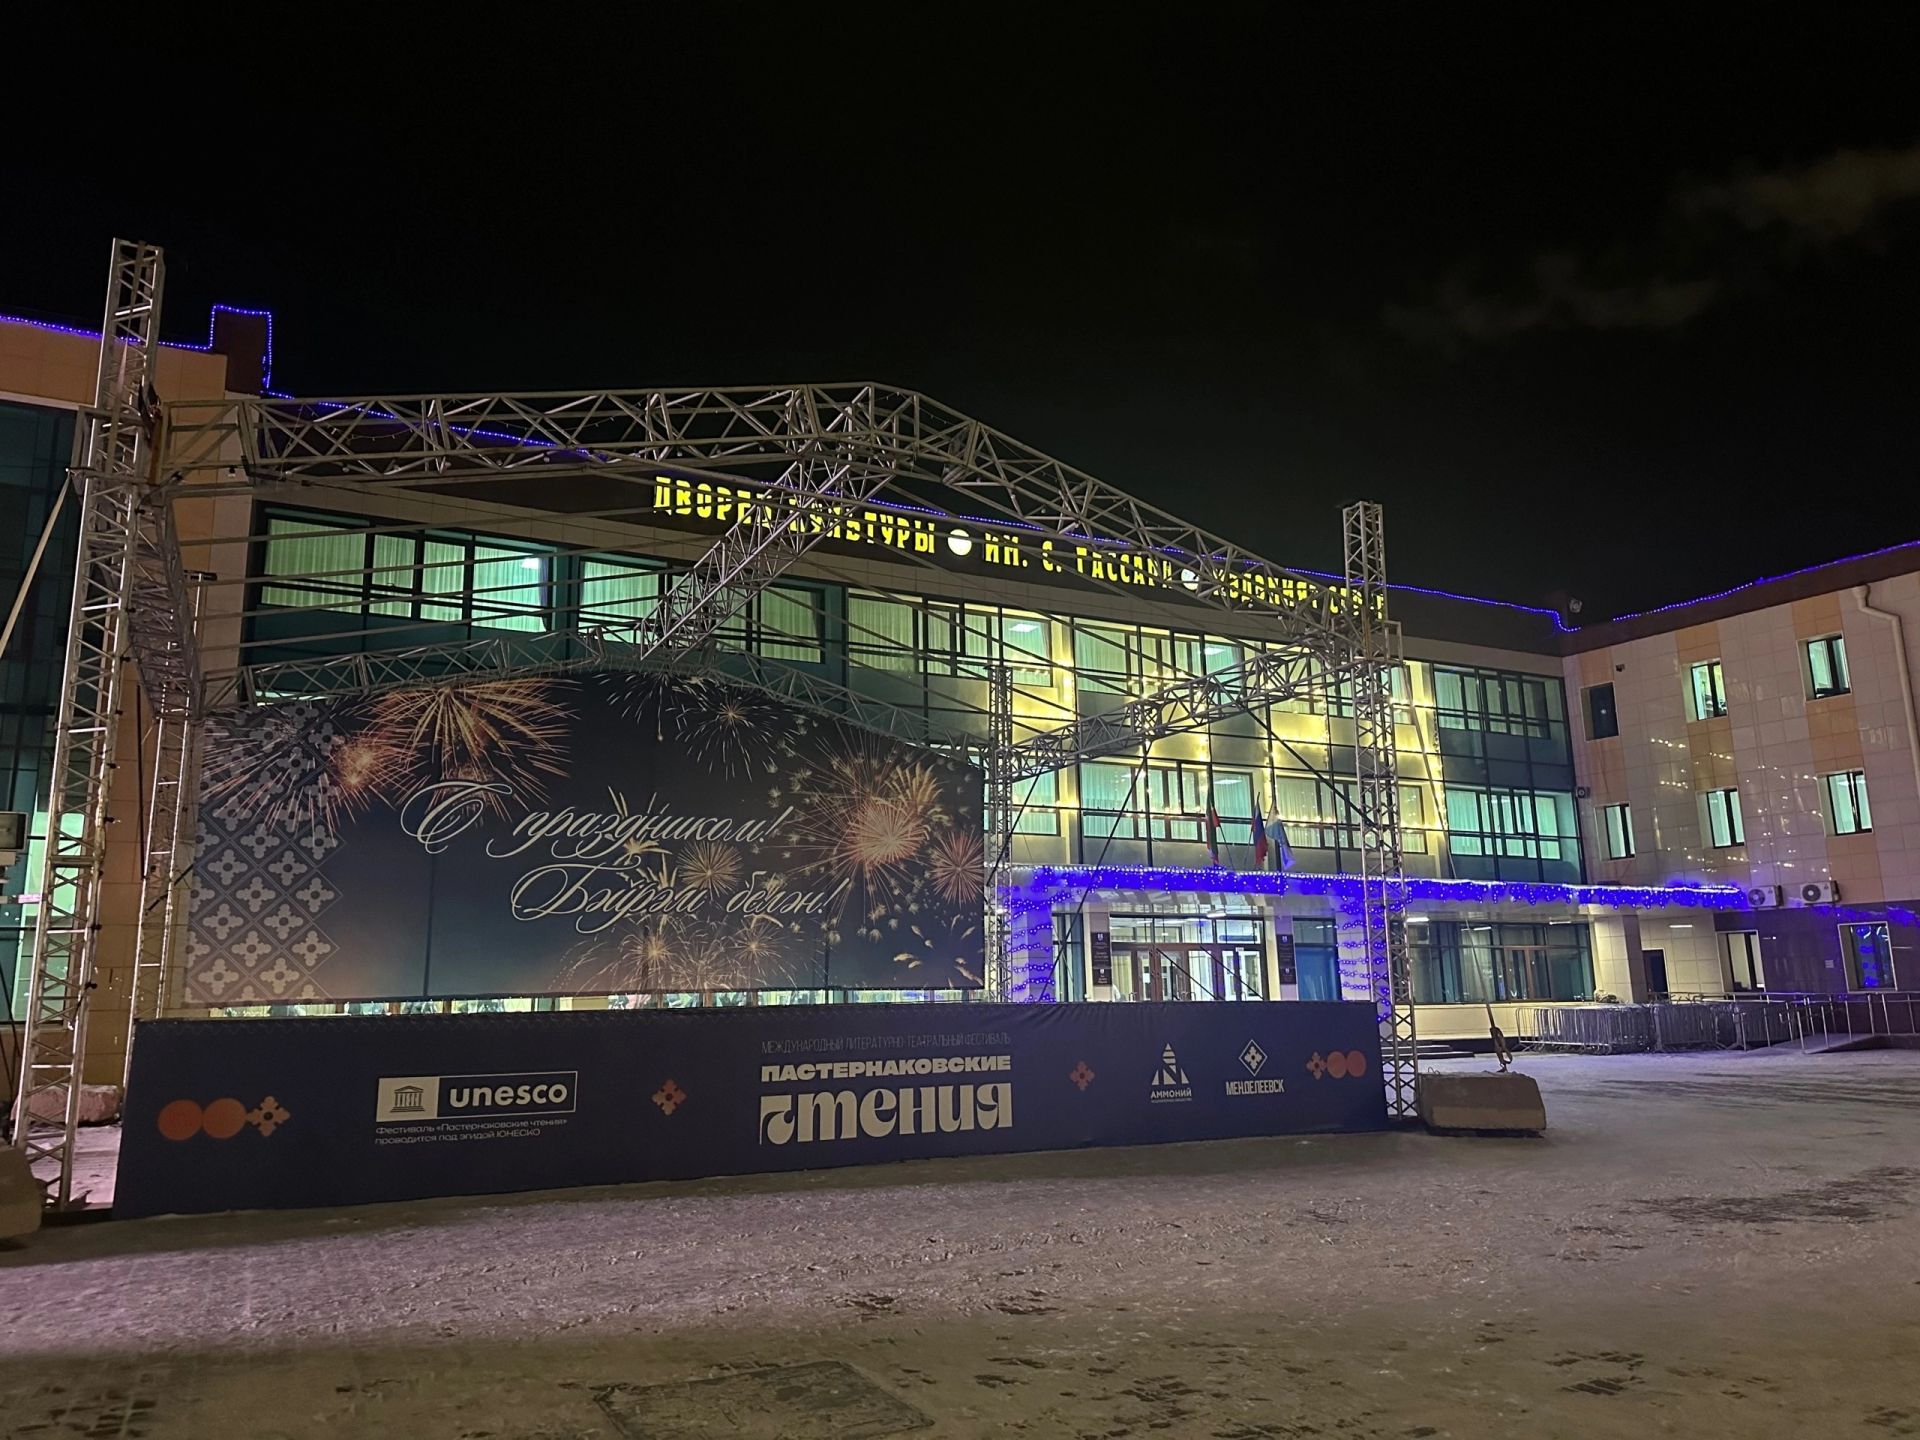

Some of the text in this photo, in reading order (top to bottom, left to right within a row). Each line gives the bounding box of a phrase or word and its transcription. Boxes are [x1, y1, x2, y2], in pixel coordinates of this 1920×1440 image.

[985, 532, 1028, 568] ИМ.
[1042, 540, 1062, 573] С.
[400, 781, 794, 858] С праздником!
[761, 1036, 844, 1054] МЕЖДУНАРОДНЫЙ
[964, 1031, 1012, 1047] ФЕСТИВАЛЬ
[761, 1055, 1012, 1082] ПАСТЕРНАКОВСКИЕ
[450, 1083, 568, 1108] unesco
[1150, 1087, 1192, 1099] АММОНИЙ
[1225, 1079, 1285, 1096] МЕНДЕЛЕЕВСК
[375, 1124, 435, 1136] Фестиваль
[375, 1127, 541, 1146] проводится под эгидой ЮНЕСКО
